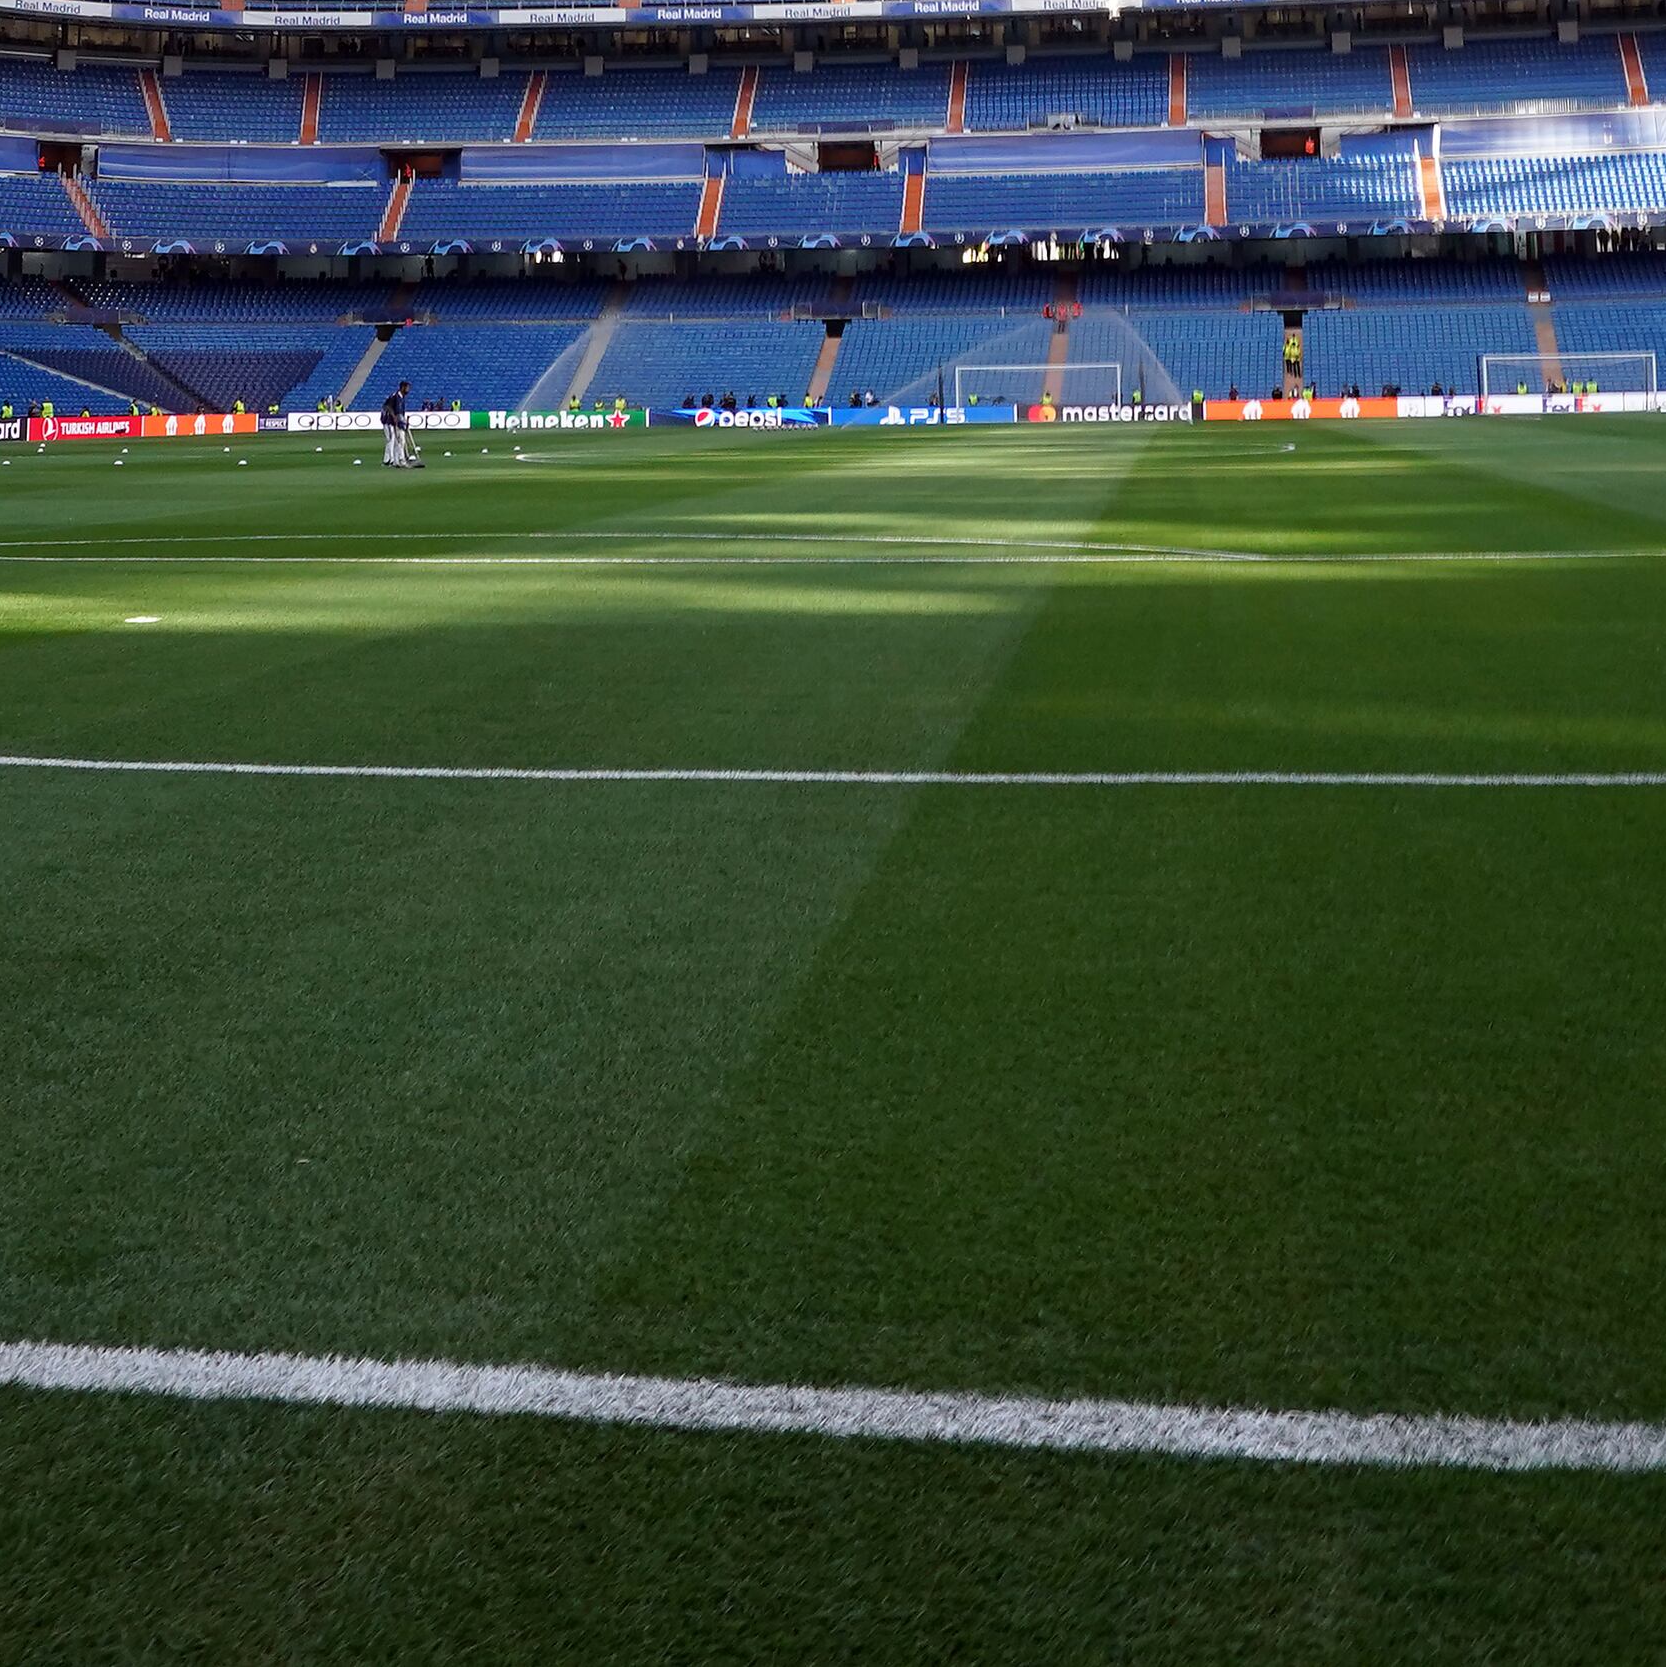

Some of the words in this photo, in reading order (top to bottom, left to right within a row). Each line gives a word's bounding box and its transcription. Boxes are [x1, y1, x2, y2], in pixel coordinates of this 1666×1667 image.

[42, 1, 81, 15] Madrid
[785, 8, 810, 18] Real
[813, 6, 850, 18] Madrid
[914, 0, 939, 13] Real
[941, 0, 979, 12] Madrid
[144, 8, 169, 20] Real
[172, 9, 210, 22] Madrid
[274, 15, 300, 26] Real
[303, 15, 340, 26] Madrid
[404, 13, 428, 24] Real
[430, 12, 467, 24] Madrid
[530, 12, 554, 23] Real
[557, 12, 595, 23] Madrid
[657, 9, 682, 20] Real
[684, 8, 721, 20] Madrid
[1062, 401, 1192, 422] mastercard
[298, 414, 371, 430] oppo
[488, 410, 604, 429] Heineken
[60, 422, 95, 435] TURKISH
[96, 420, 130, 434] AIRLINES
